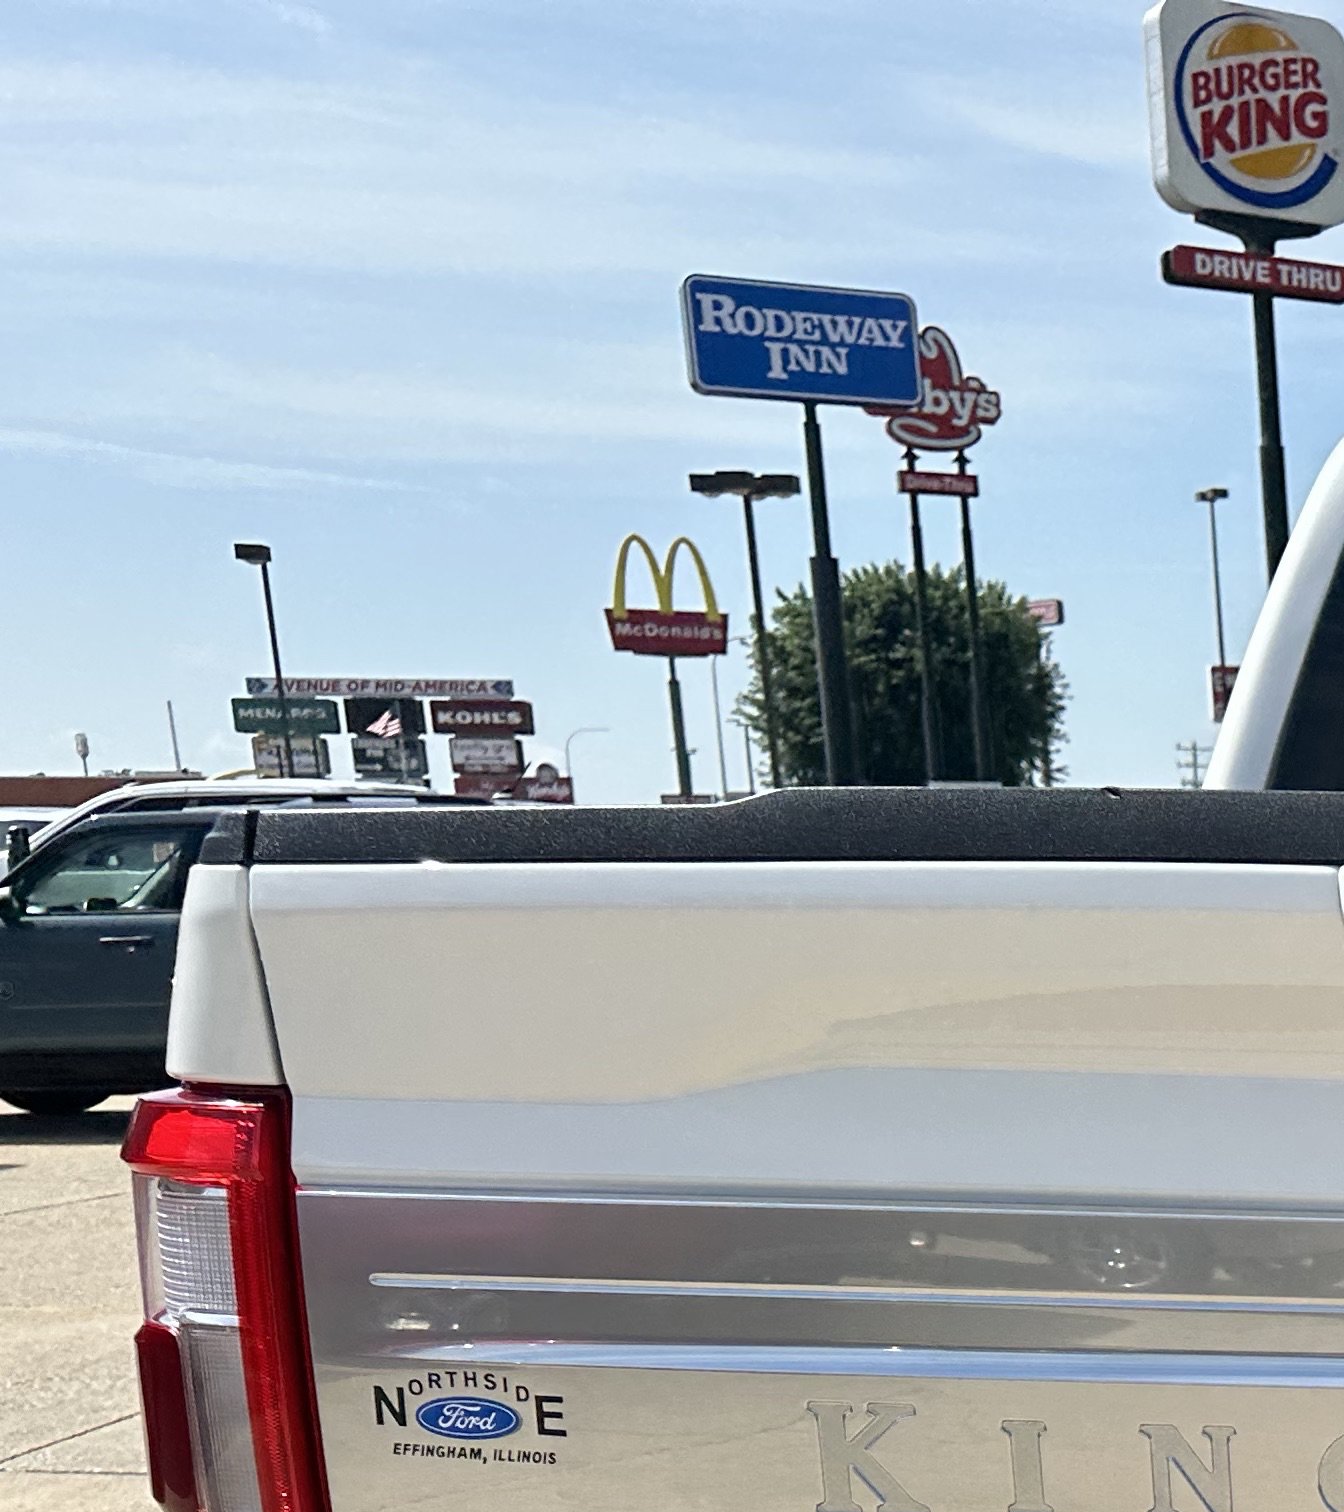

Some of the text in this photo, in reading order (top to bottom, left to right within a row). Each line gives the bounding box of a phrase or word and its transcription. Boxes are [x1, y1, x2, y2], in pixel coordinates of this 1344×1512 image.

[1190, 57, 1322, 109] BURGER
[1200, 91, 1329, 160] KING
[1194, 252, 1342, 293] DRIVE THRU
[695, 292, 908, 347] RODEWAY
[763, 340, 849, 380] INN
[919, 376, 1000, 427] by's
[615, 621, 723, 640] McDonald's
[346, 679, 370, 692] OF
[373, 1370, 567, 1437] NORTHSIDE
[438, 1403, 497, 1431] Ford
[392, 1442, 557, 1465] EFFINGHAM, ILLINOIS
